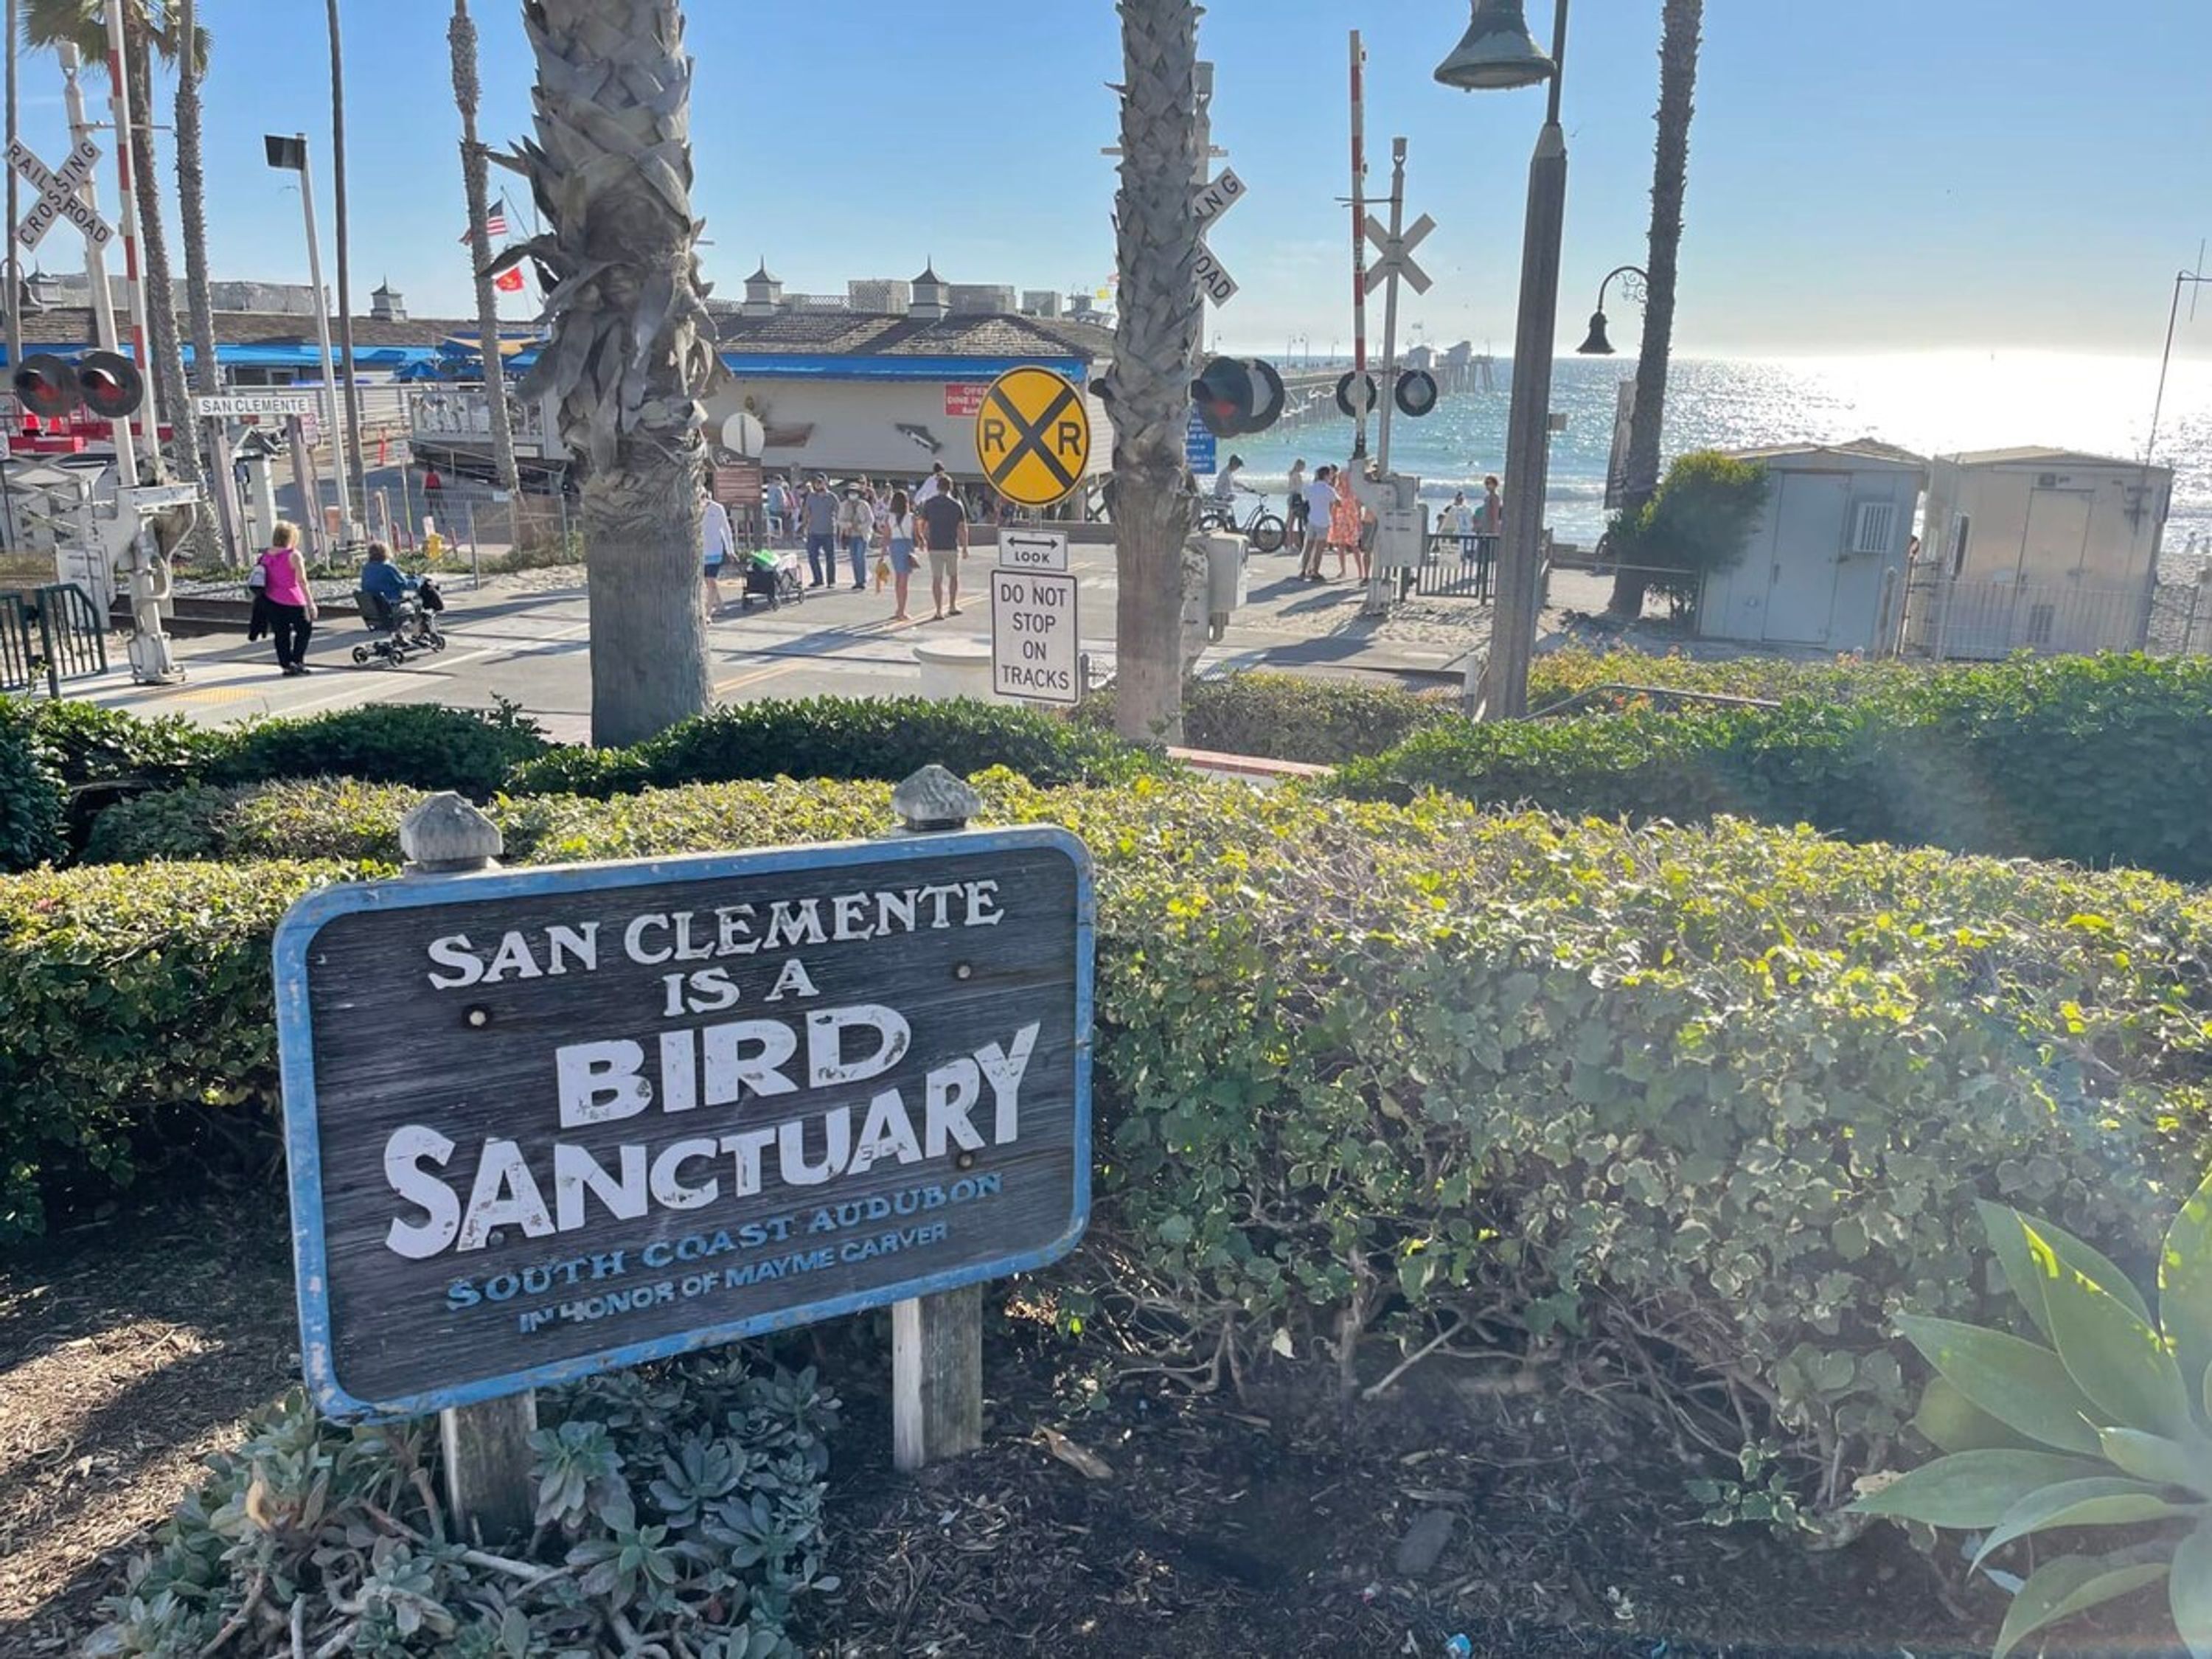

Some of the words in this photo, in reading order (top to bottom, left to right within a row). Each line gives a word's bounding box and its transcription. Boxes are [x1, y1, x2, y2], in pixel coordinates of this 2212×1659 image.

[20, 142, 96, 245] CROSSING
[202, 400, 232, 412] SAN
[235, 400, 306, 412] CLEMENTE
[1015, 551, 1050, 563] LOOK
[1001, 584, 1024, 604] DO
[1033, 587, 1067, 607] NOT
[1012, 612, 1056, 633] STOP
[1001, 665, 1070, 690] TRACKS
[1022, 640, 1047, 661] ON
[427, 921, 601, 990] SAN
[623, 879, 1005, 965] CLEMENTE
[663, 967, 740, 1018] IS
[764, 959, 821, 1002] A
[555, 1004, 911, 1129] BIRD
[383, 1019, 1041, 1260] SANCTUARY
[445, 1249, 626, 1312] SOUTH
[641, 1214, 796, 1268] COAST
[808, 1172, 1004, 1234] AUDUBON
[519, 1307, 554, 1334] IN
[681, 1271, 720, 1298] OF
[726, 1245, 836, 1290] MAYME
[841, 1220, 948, 1262] CARVER
